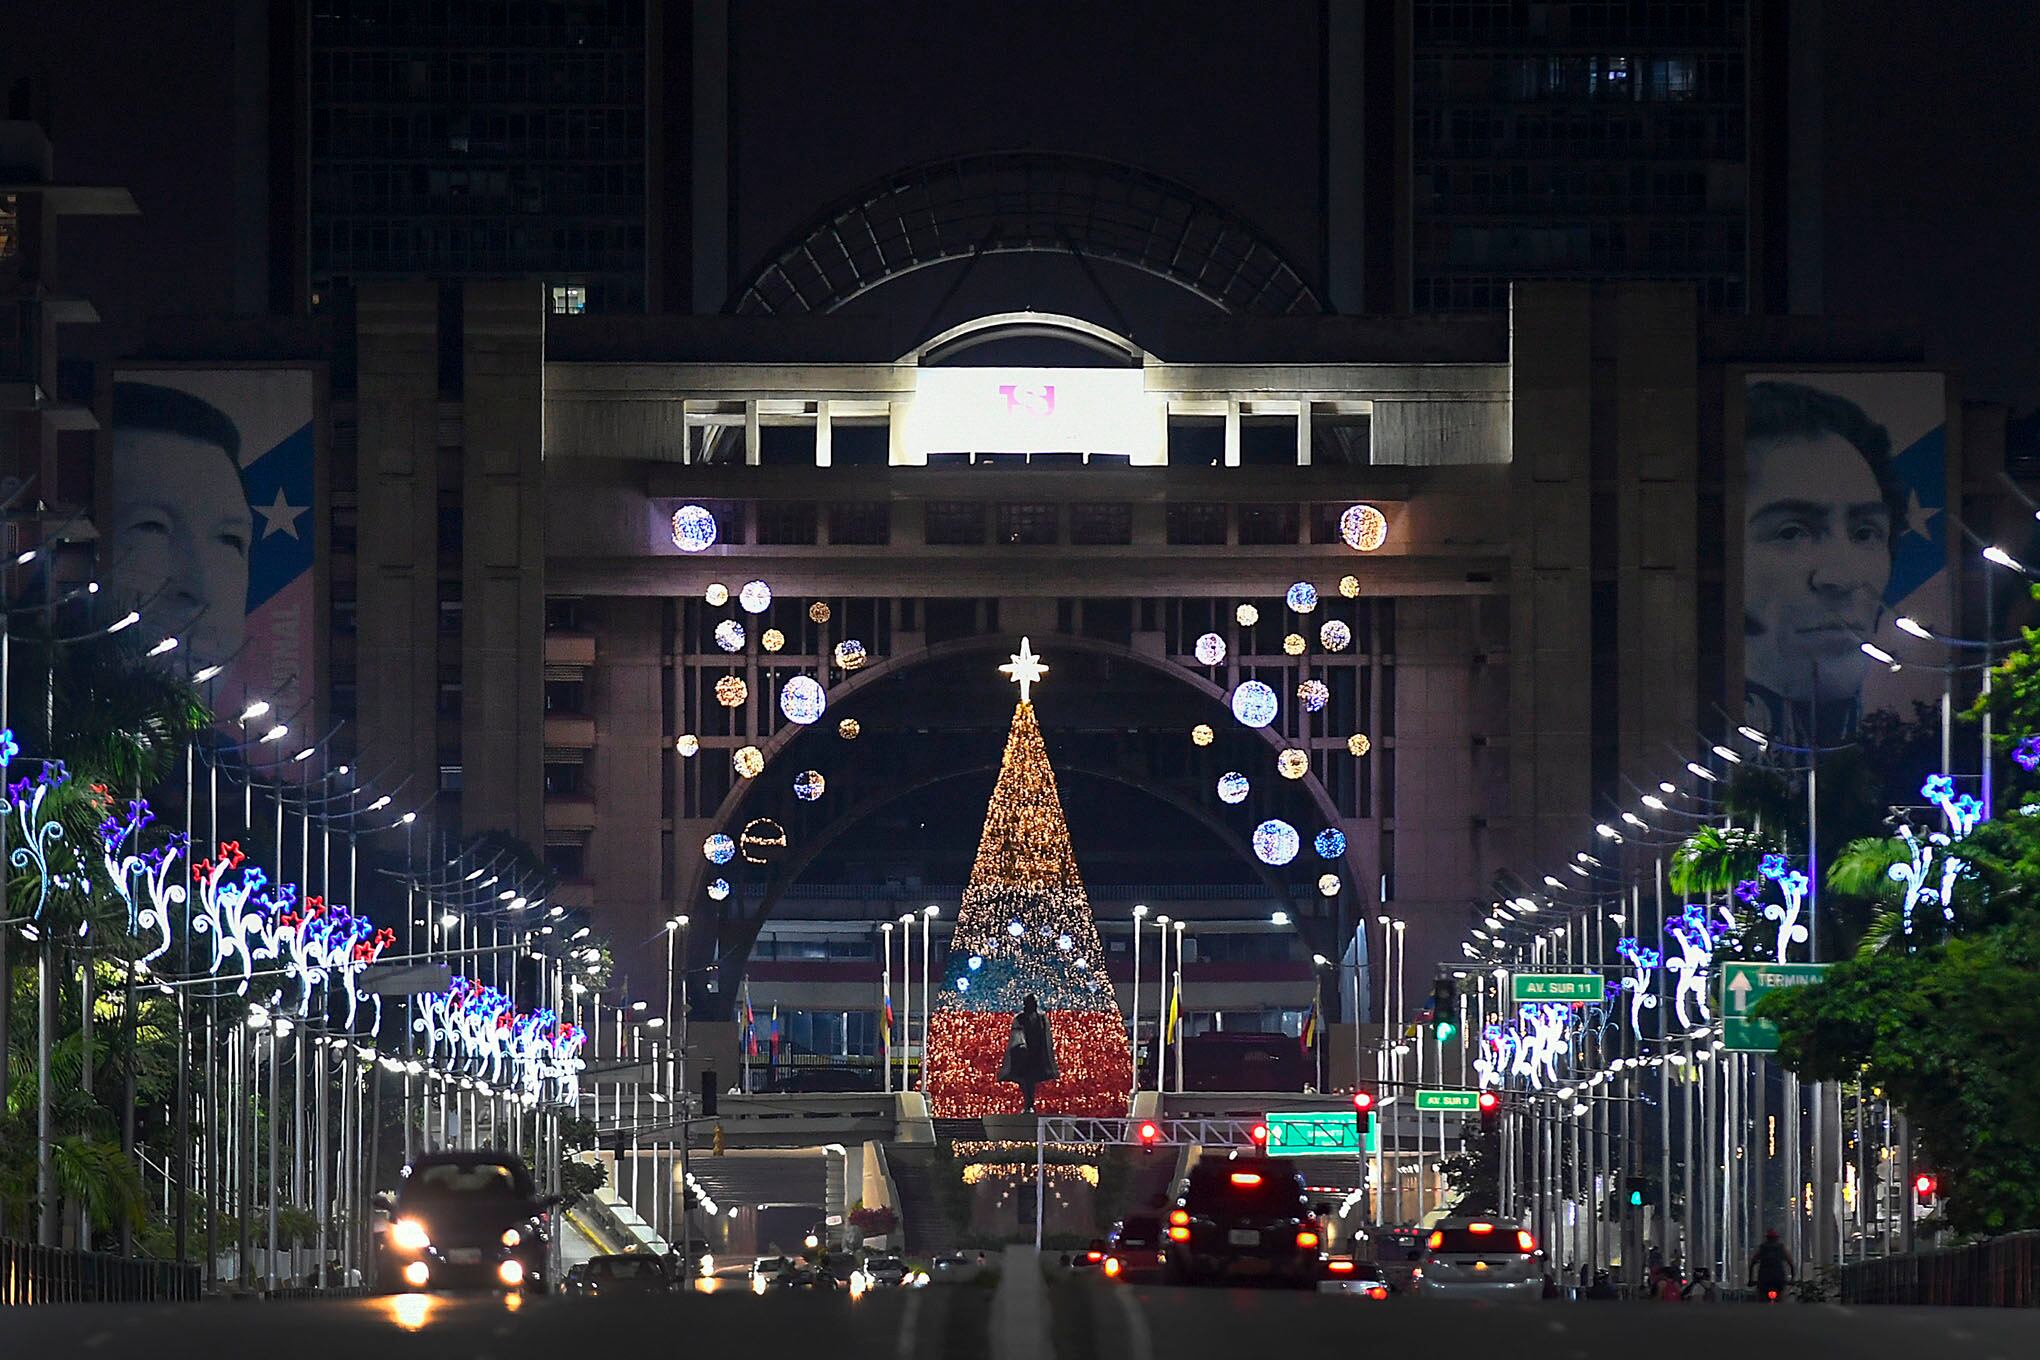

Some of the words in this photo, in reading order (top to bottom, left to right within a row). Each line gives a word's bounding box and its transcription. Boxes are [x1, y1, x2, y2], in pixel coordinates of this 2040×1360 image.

[1527, 982, 1546, 993] AV.
[1549, 982, 1575, 993] SUR
[1578, 983, 1591, 993] 11
[1443, 1096, 1461, 1105] SUR
